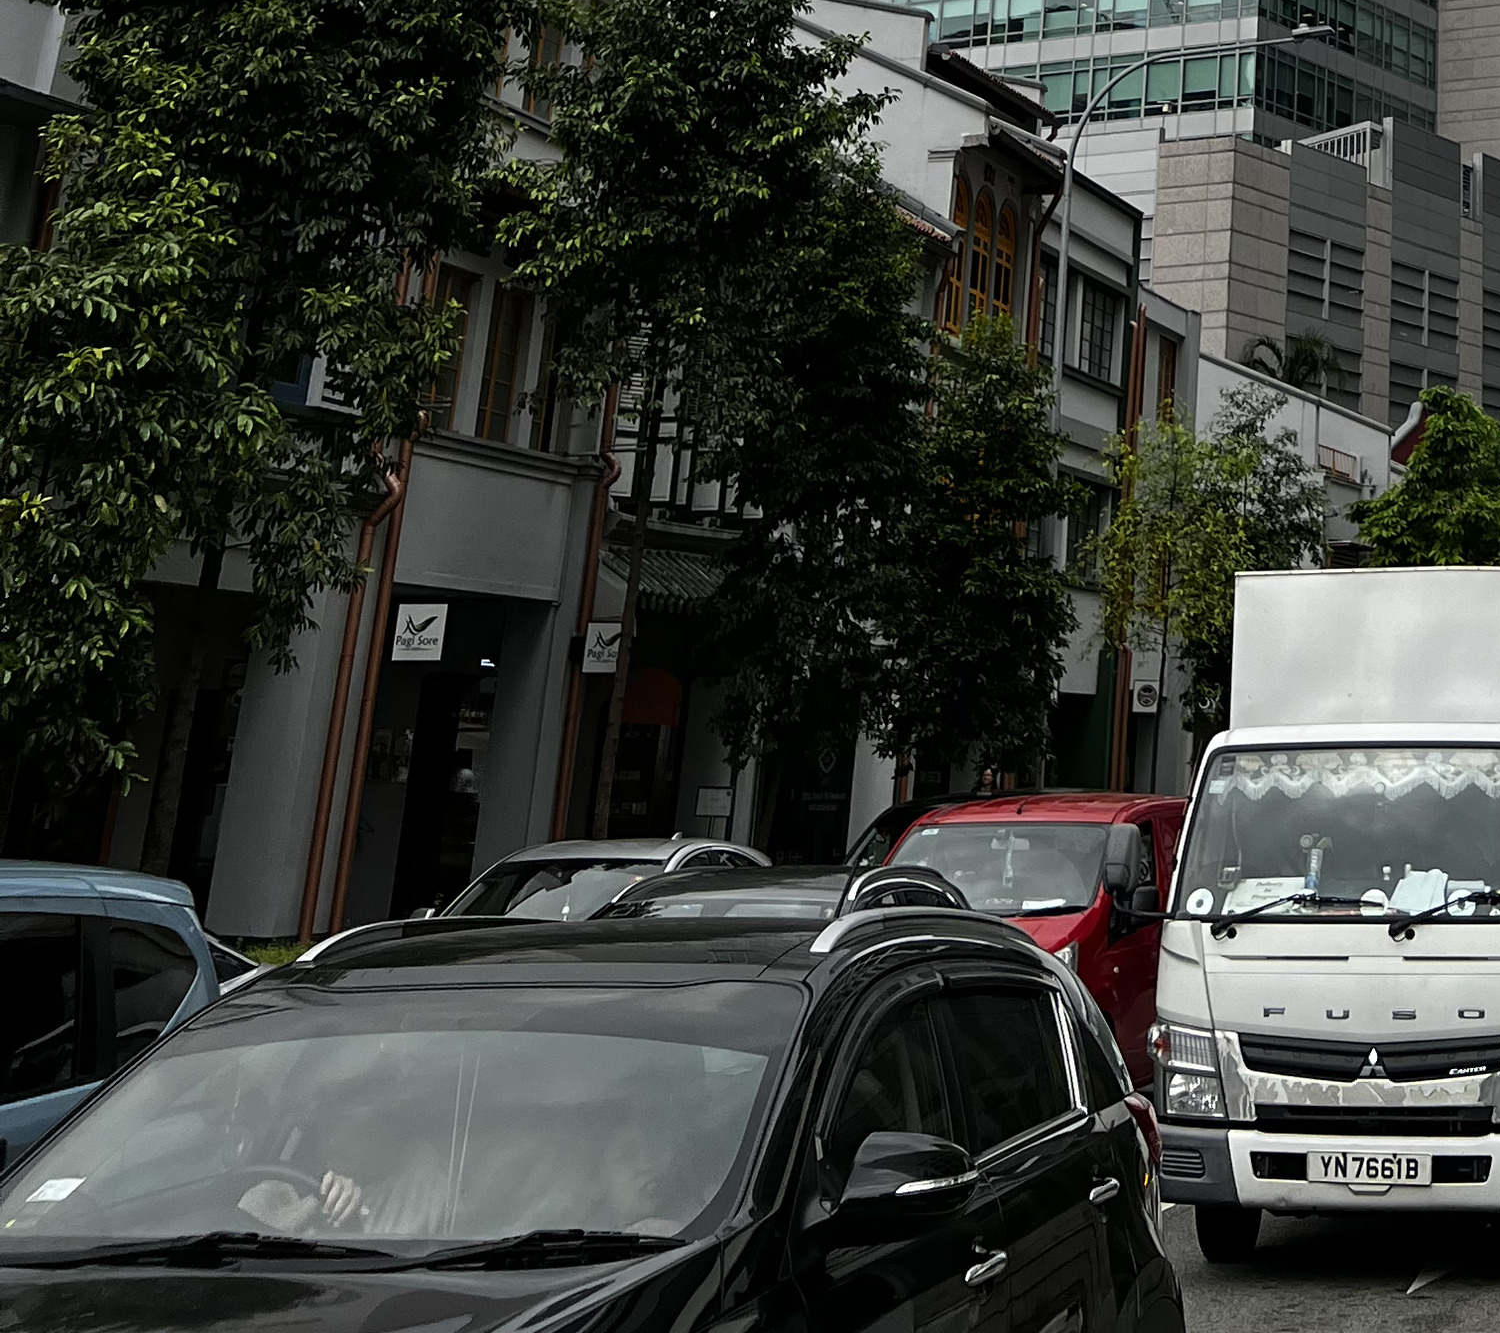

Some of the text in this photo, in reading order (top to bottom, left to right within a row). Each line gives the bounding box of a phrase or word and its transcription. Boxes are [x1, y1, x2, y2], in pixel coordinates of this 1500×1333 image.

[395, 635, 439, 648] Pagi Sore
[587, 648, 605, 661] Pagi
[1263, 1006, 1485, 1020] FUSO
